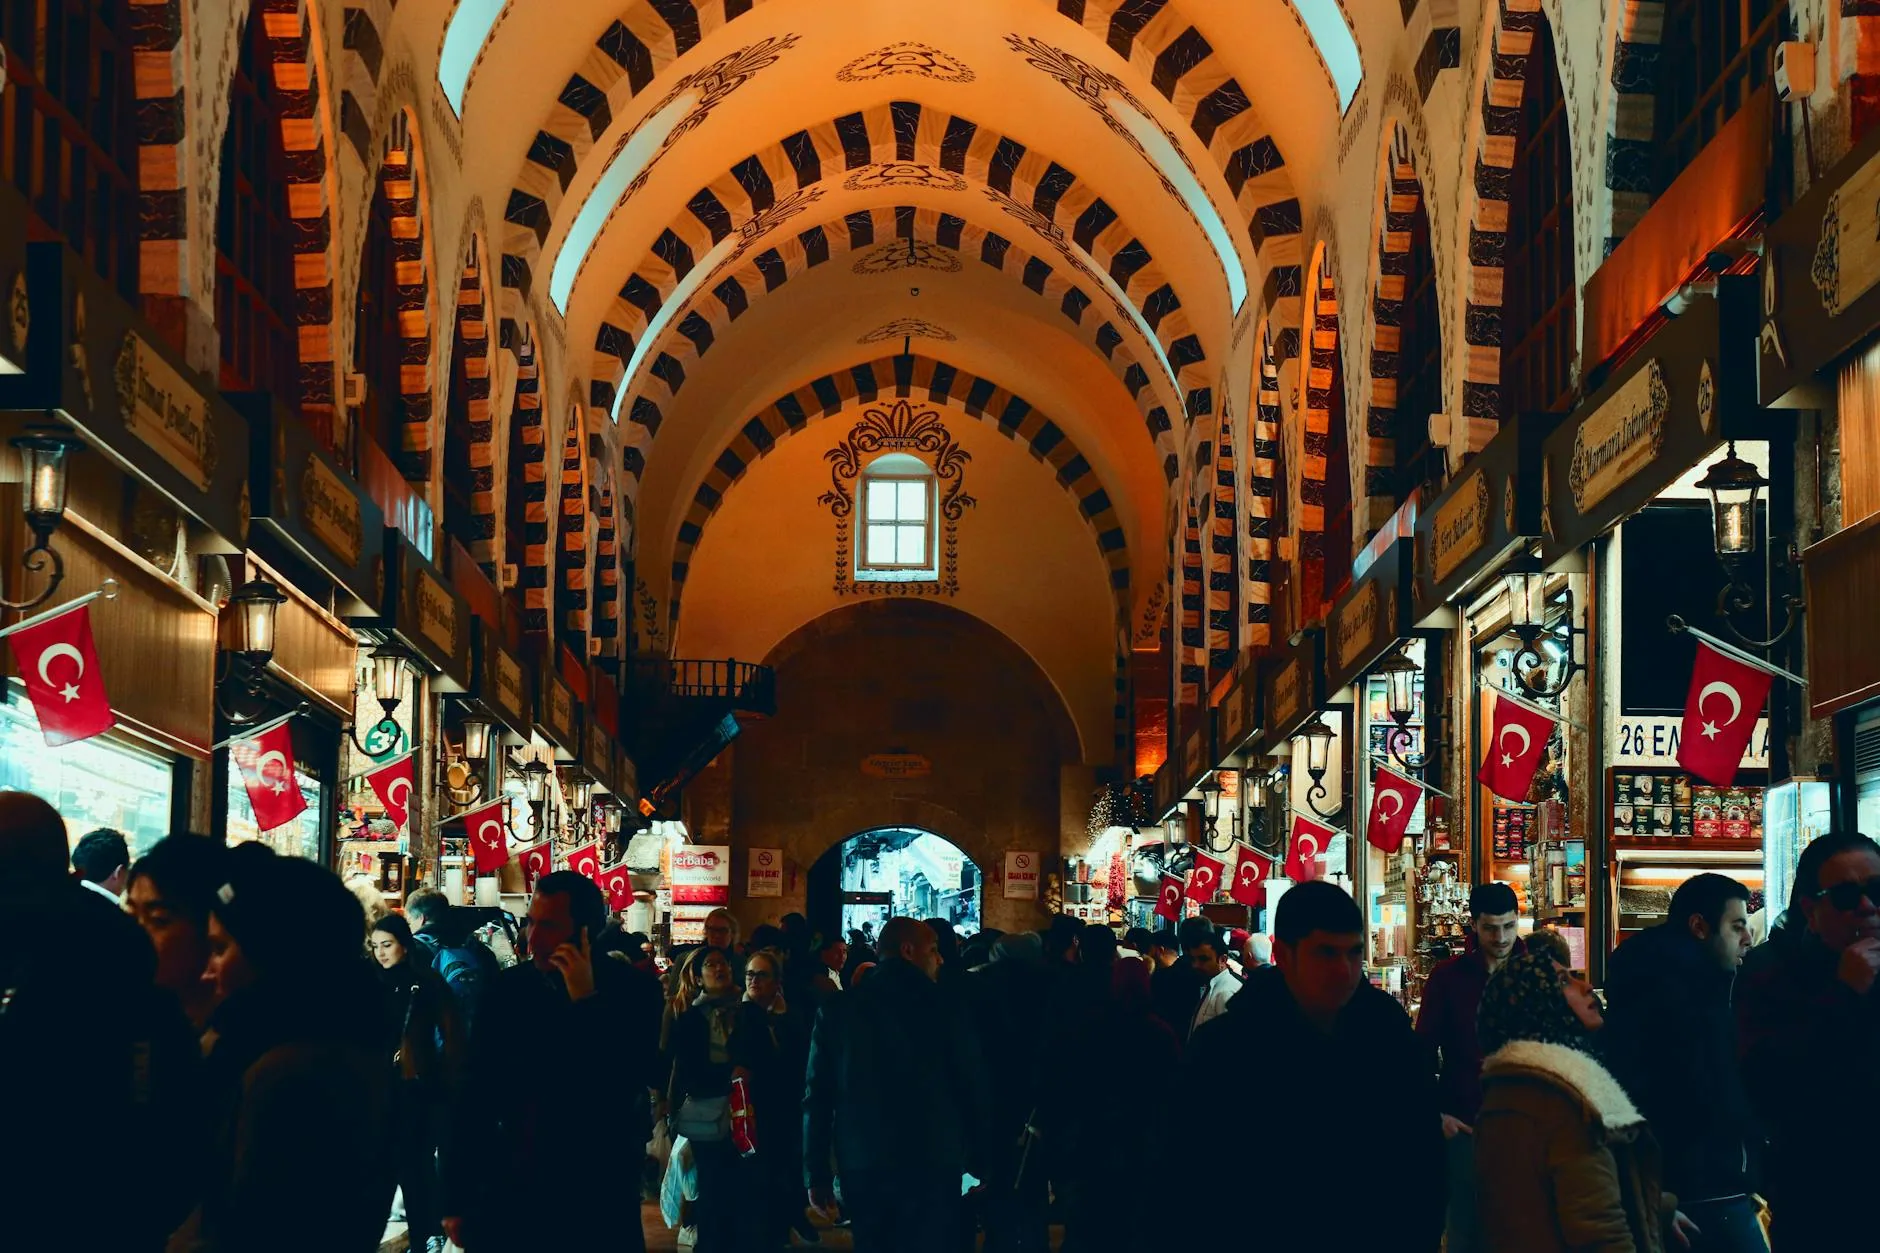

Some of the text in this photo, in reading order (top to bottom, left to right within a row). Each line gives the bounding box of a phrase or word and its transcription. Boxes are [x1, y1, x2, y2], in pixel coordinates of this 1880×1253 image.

[1700, 378, 1712, 415] 26
[369, 730, 405, 756] 31
[1619, 724, 1644, 757] 26
